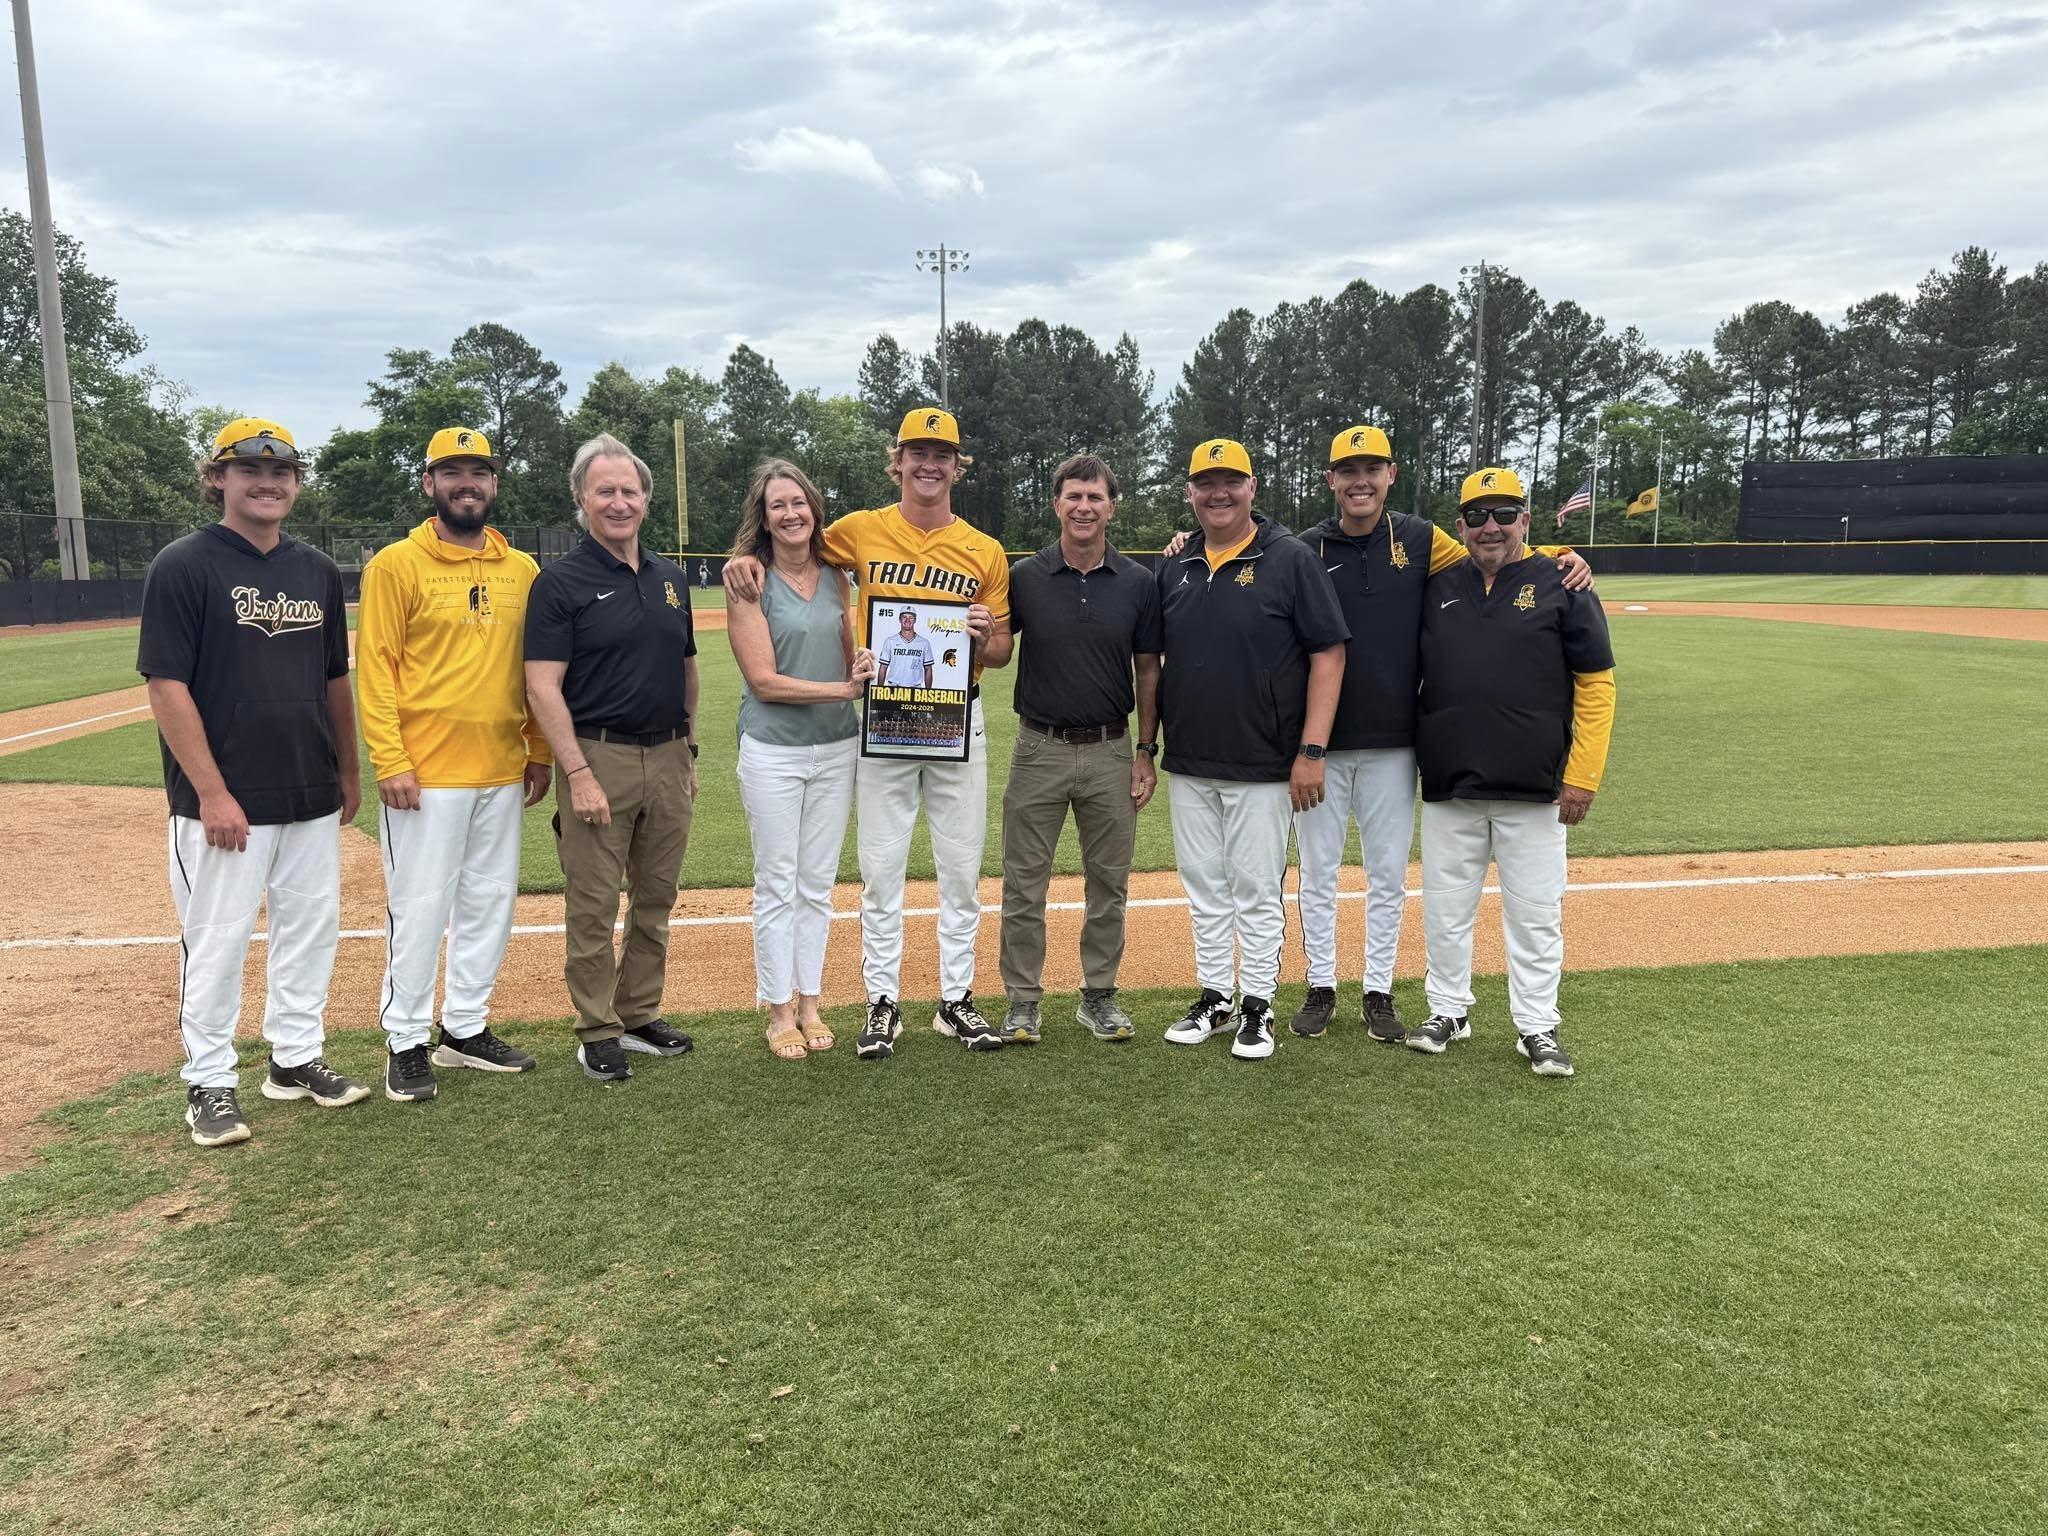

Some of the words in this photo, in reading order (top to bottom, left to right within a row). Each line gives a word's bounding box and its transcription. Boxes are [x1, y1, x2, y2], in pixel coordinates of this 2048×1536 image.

[495, 576, 516, 584] TECH
[868, 560, 980, 599] TROJANS
[231, 586, 323, 631] Trojans
[878, 608, 894, 617] #15
[460, 617, 502, 625] BASALL
[927, 617, 965, 630] LUCAS
[893, 648, 923, 657] TROJANS
[871, 686, 912, 702] TROJAN
[914, 688, 965, 704] BASEBALL
[900, 703, 935, 712] 2024-2025
